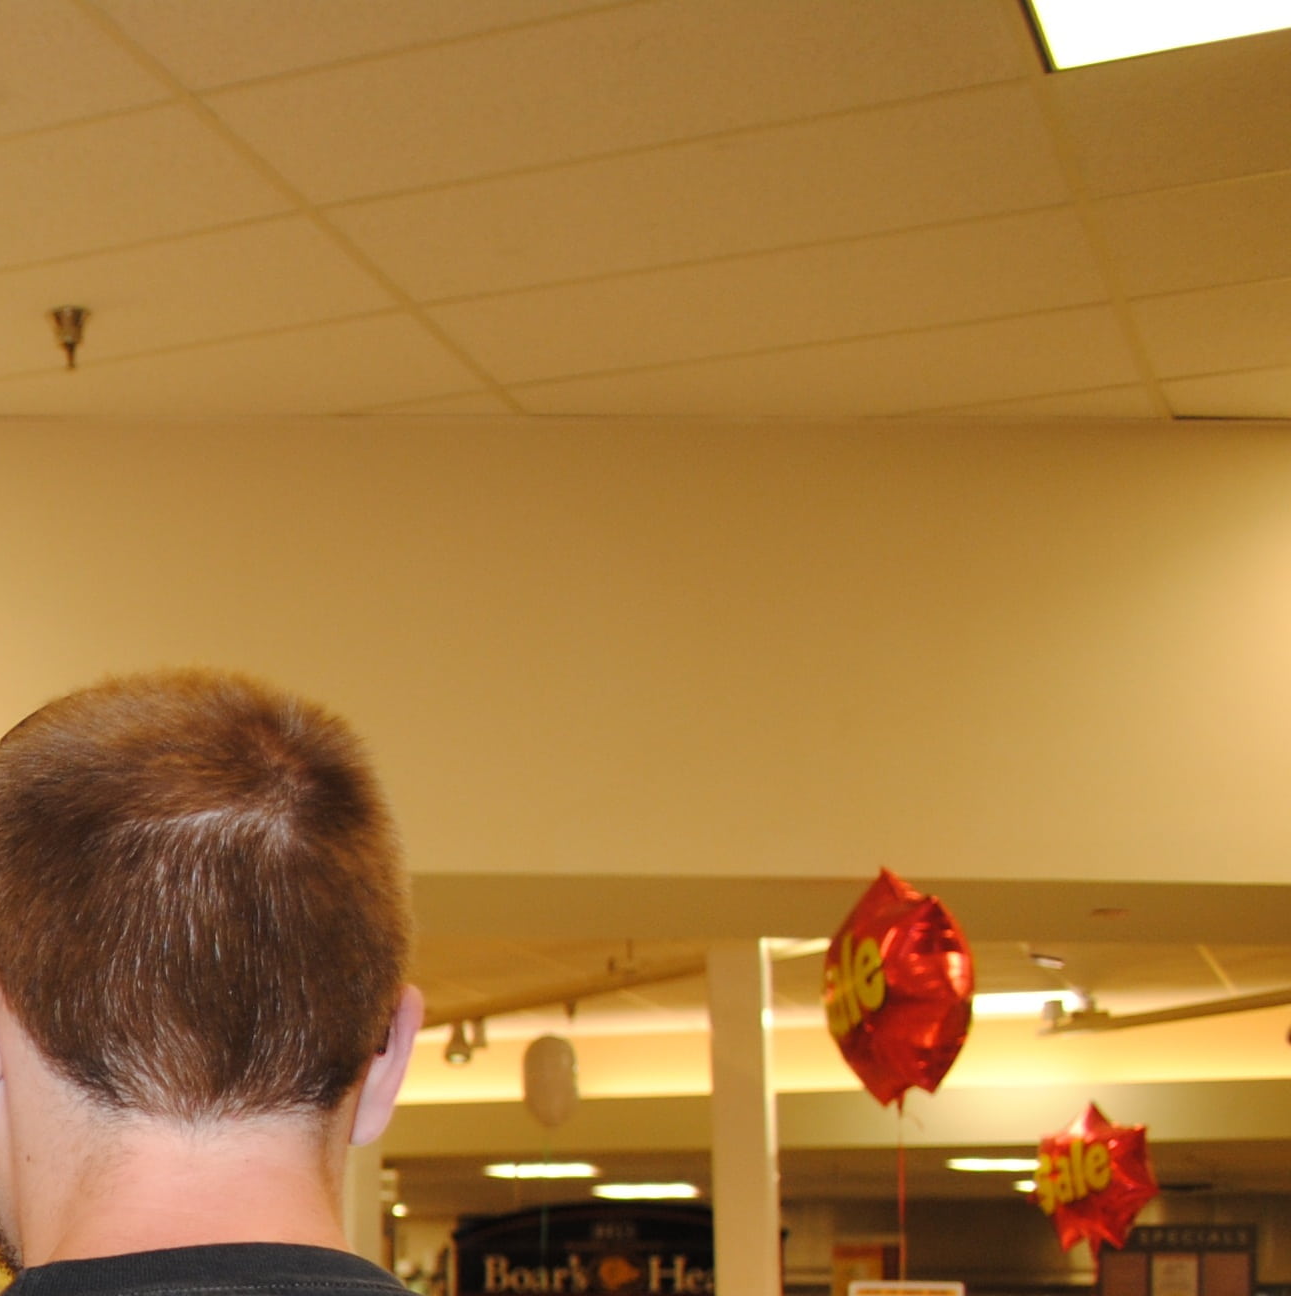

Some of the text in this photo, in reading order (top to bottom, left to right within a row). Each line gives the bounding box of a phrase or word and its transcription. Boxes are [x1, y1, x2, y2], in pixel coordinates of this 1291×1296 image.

[826, 934, 887, 1040] ale
[1139, 1230, 1250, 1246] SPECIALS
[483, 1254, 715, 1294] Boar's Hea
